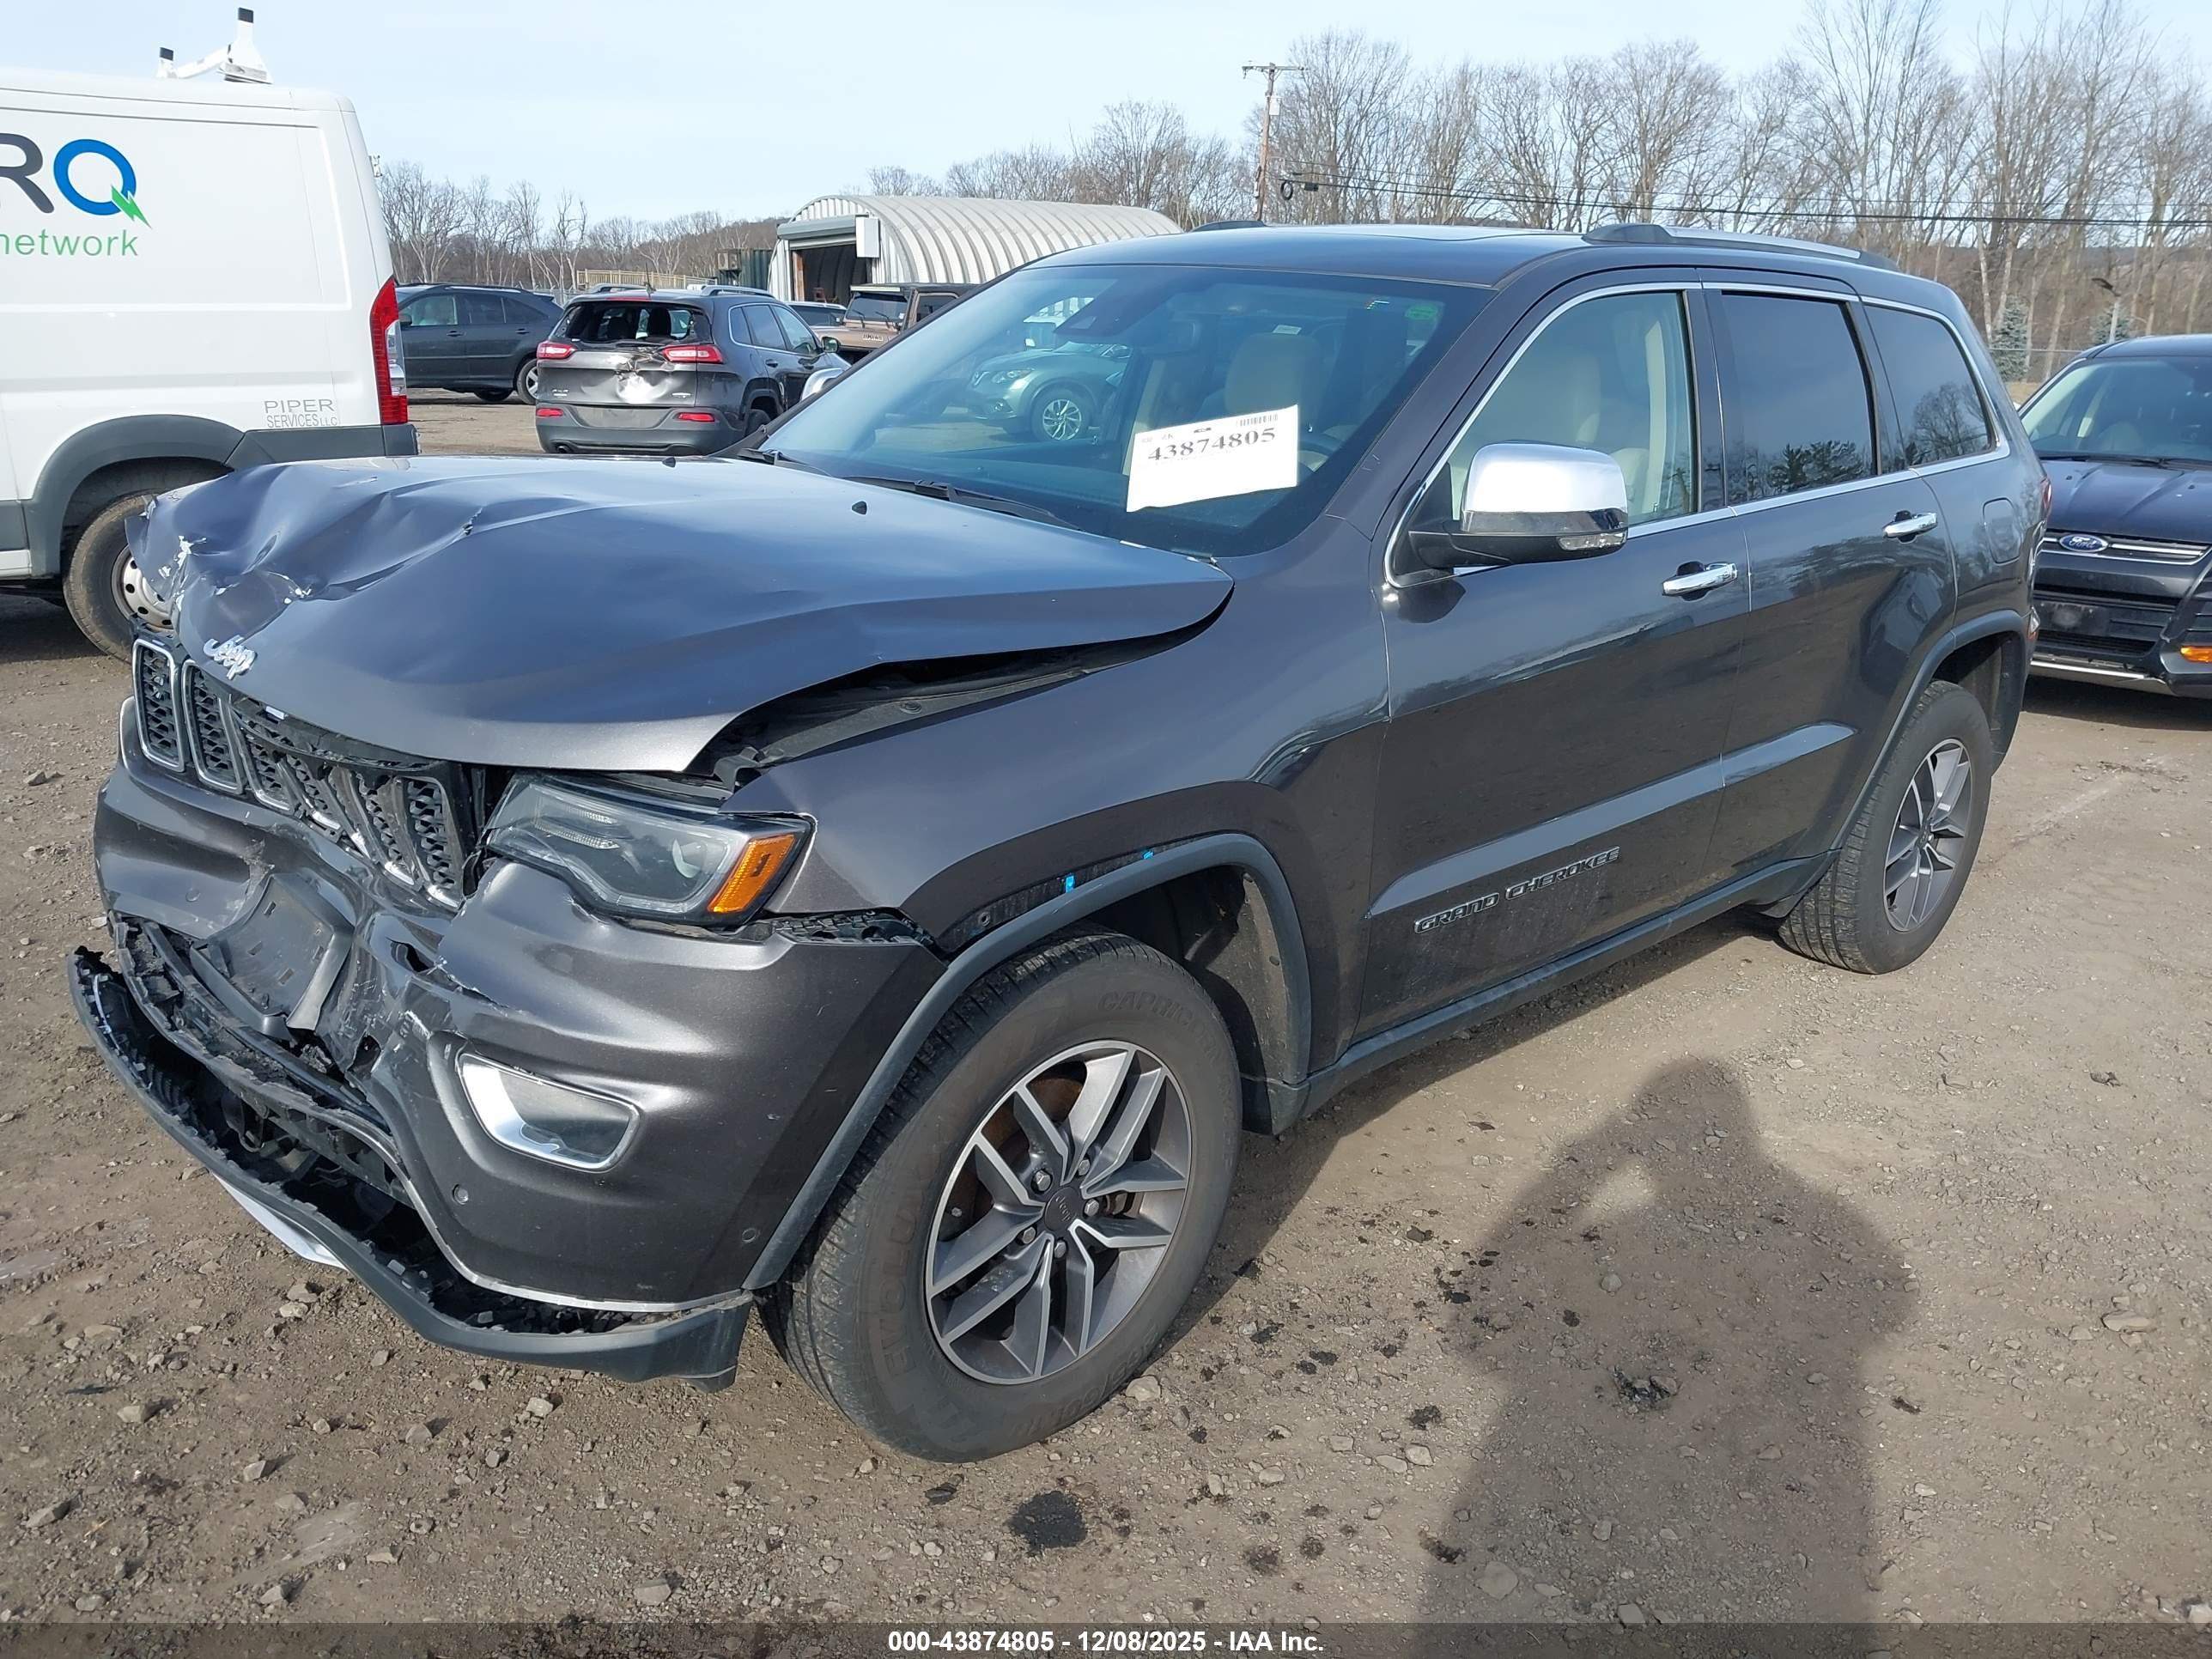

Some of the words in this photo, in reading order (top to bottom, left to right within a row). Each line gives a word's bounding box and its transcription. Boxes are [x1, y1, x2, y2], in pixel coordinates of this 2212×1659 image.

[0, 228, 138, 256] network
[264, 398, 335, 413] PIPER
[266, 413, 319, 428] SERVICES
[1148, 427, 1276, 461] 43874805
[204, 635, 256, 680] Jeep
[1413, 892, 1500, 934] GRAND
[1505, 846, 1621, 902] CHEROKEE
